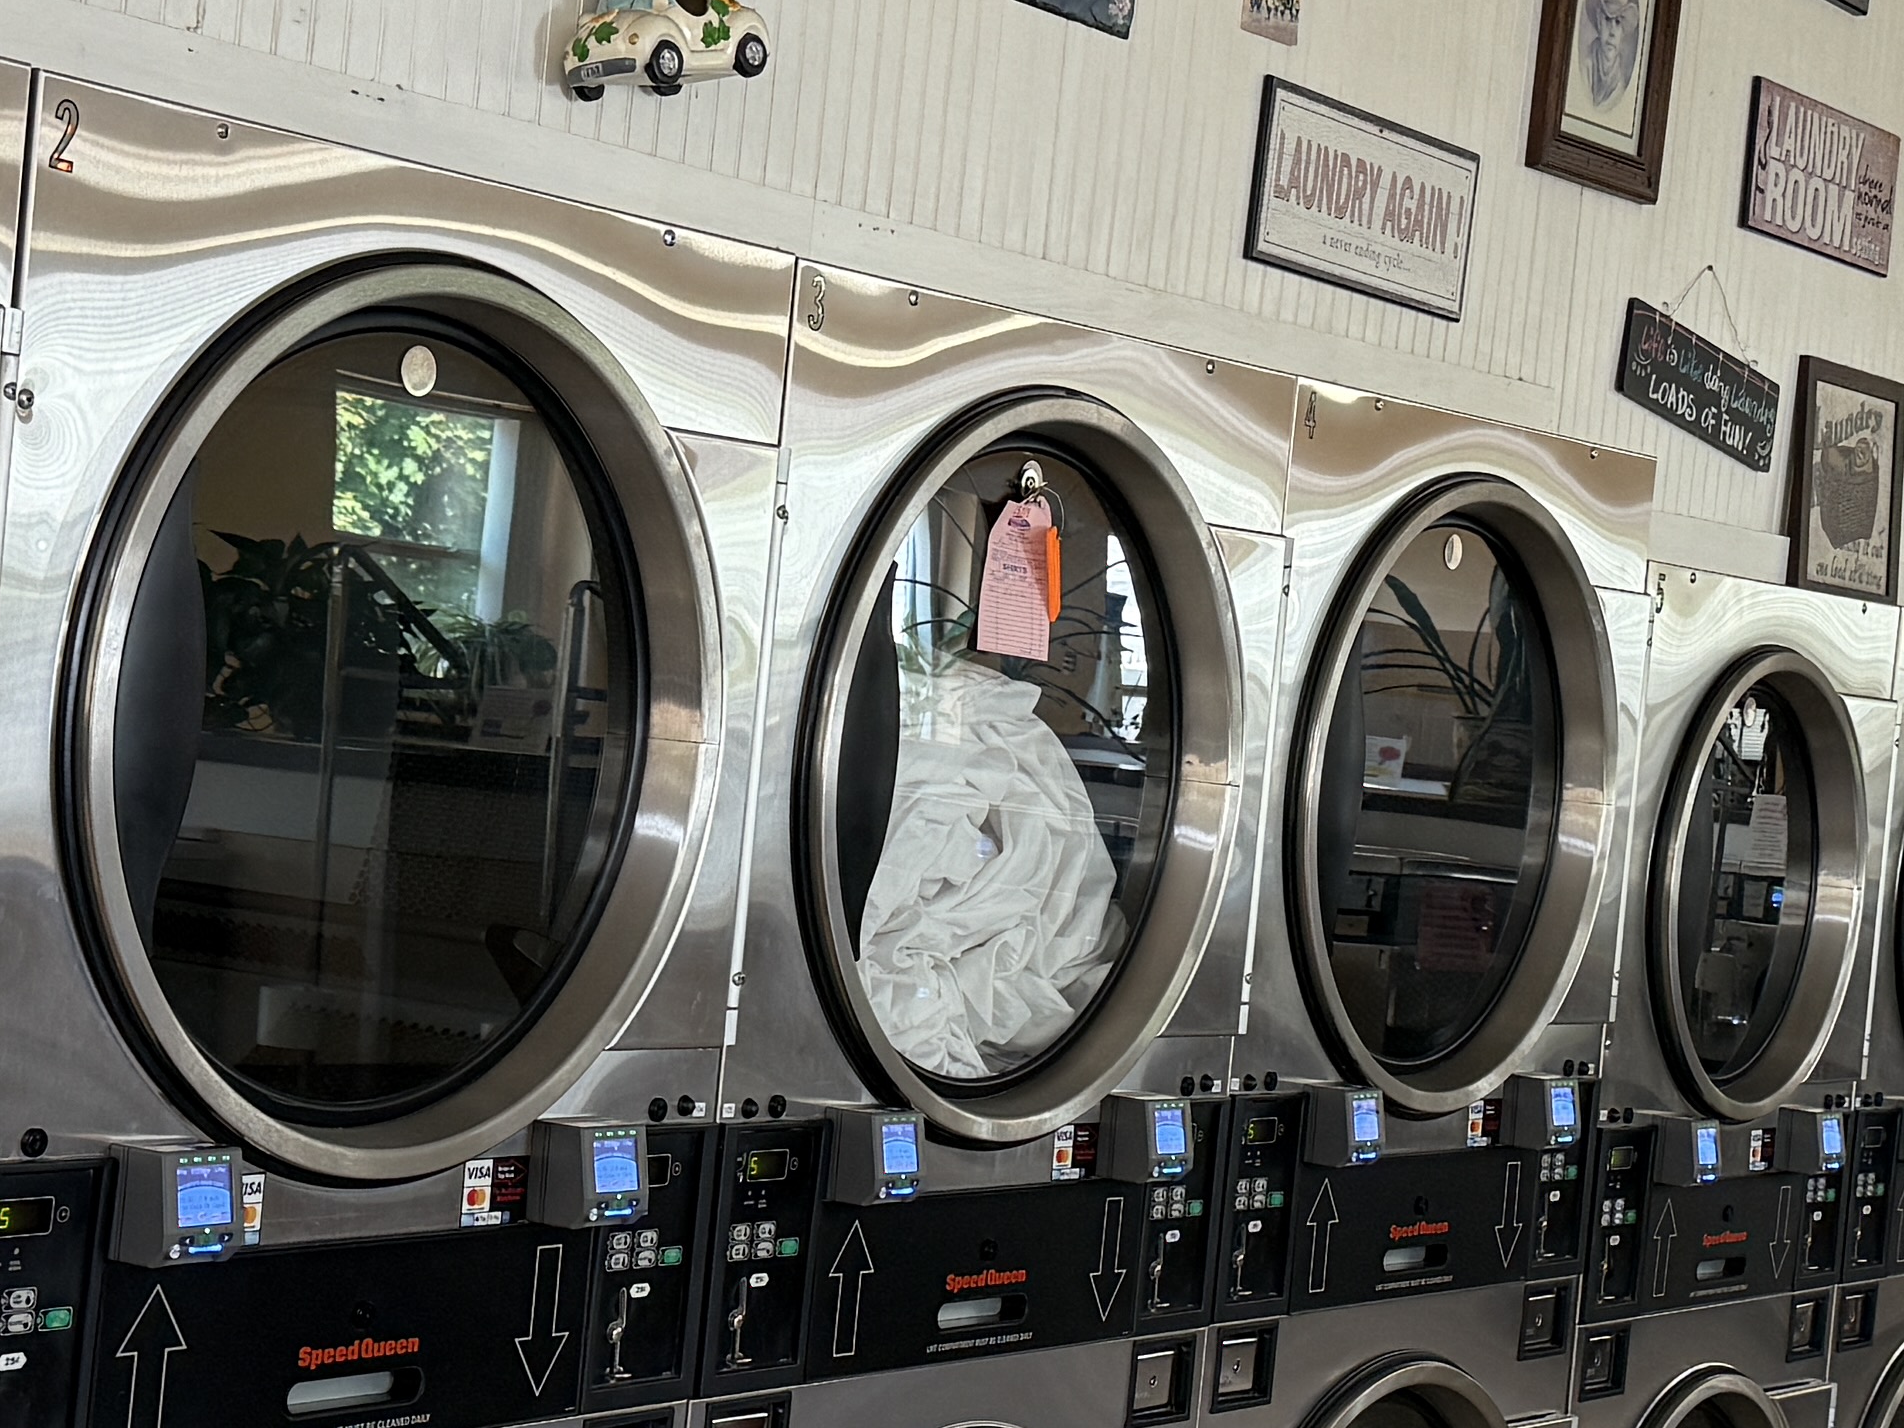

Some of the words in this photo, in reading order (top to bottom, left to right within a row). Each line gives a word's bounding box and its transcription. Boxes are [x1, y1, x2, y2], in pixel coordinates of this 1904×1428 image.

[49, 99, 79, 173] 2
[1769, 95, 1866, 192] LAUNDRY
[1272, 127, 1384, 230] LAUNDRY
[1381, 170, 1452, 255] AGAIN
[1763, 157, 1856, 253] ROOM
[1354, 242, 1383, 269] ending
[807, 274, 826, 331] 3
[1666, 345, 1678, 366] is
[1304, 390, 1318, 440] 4
[1648, 374, 1697, 422] LOADS
[1701, 406, 1718, 434] OF
[1720, 413, 1753, 455] FUN!
[1654, 573, 1666, 614] 5
[243, 1180, 262, 1196] ISA
[467, 1166, 491, 1180] VISA
[945, 1270, 987, 1293] Speed
[987, 1269, 1027, 1285] Queen
[298, 1340, 360, 1370] Speed
[361, 1337, 420, 1359] Queen
[411, 1413, 431, 1425] DAILY
